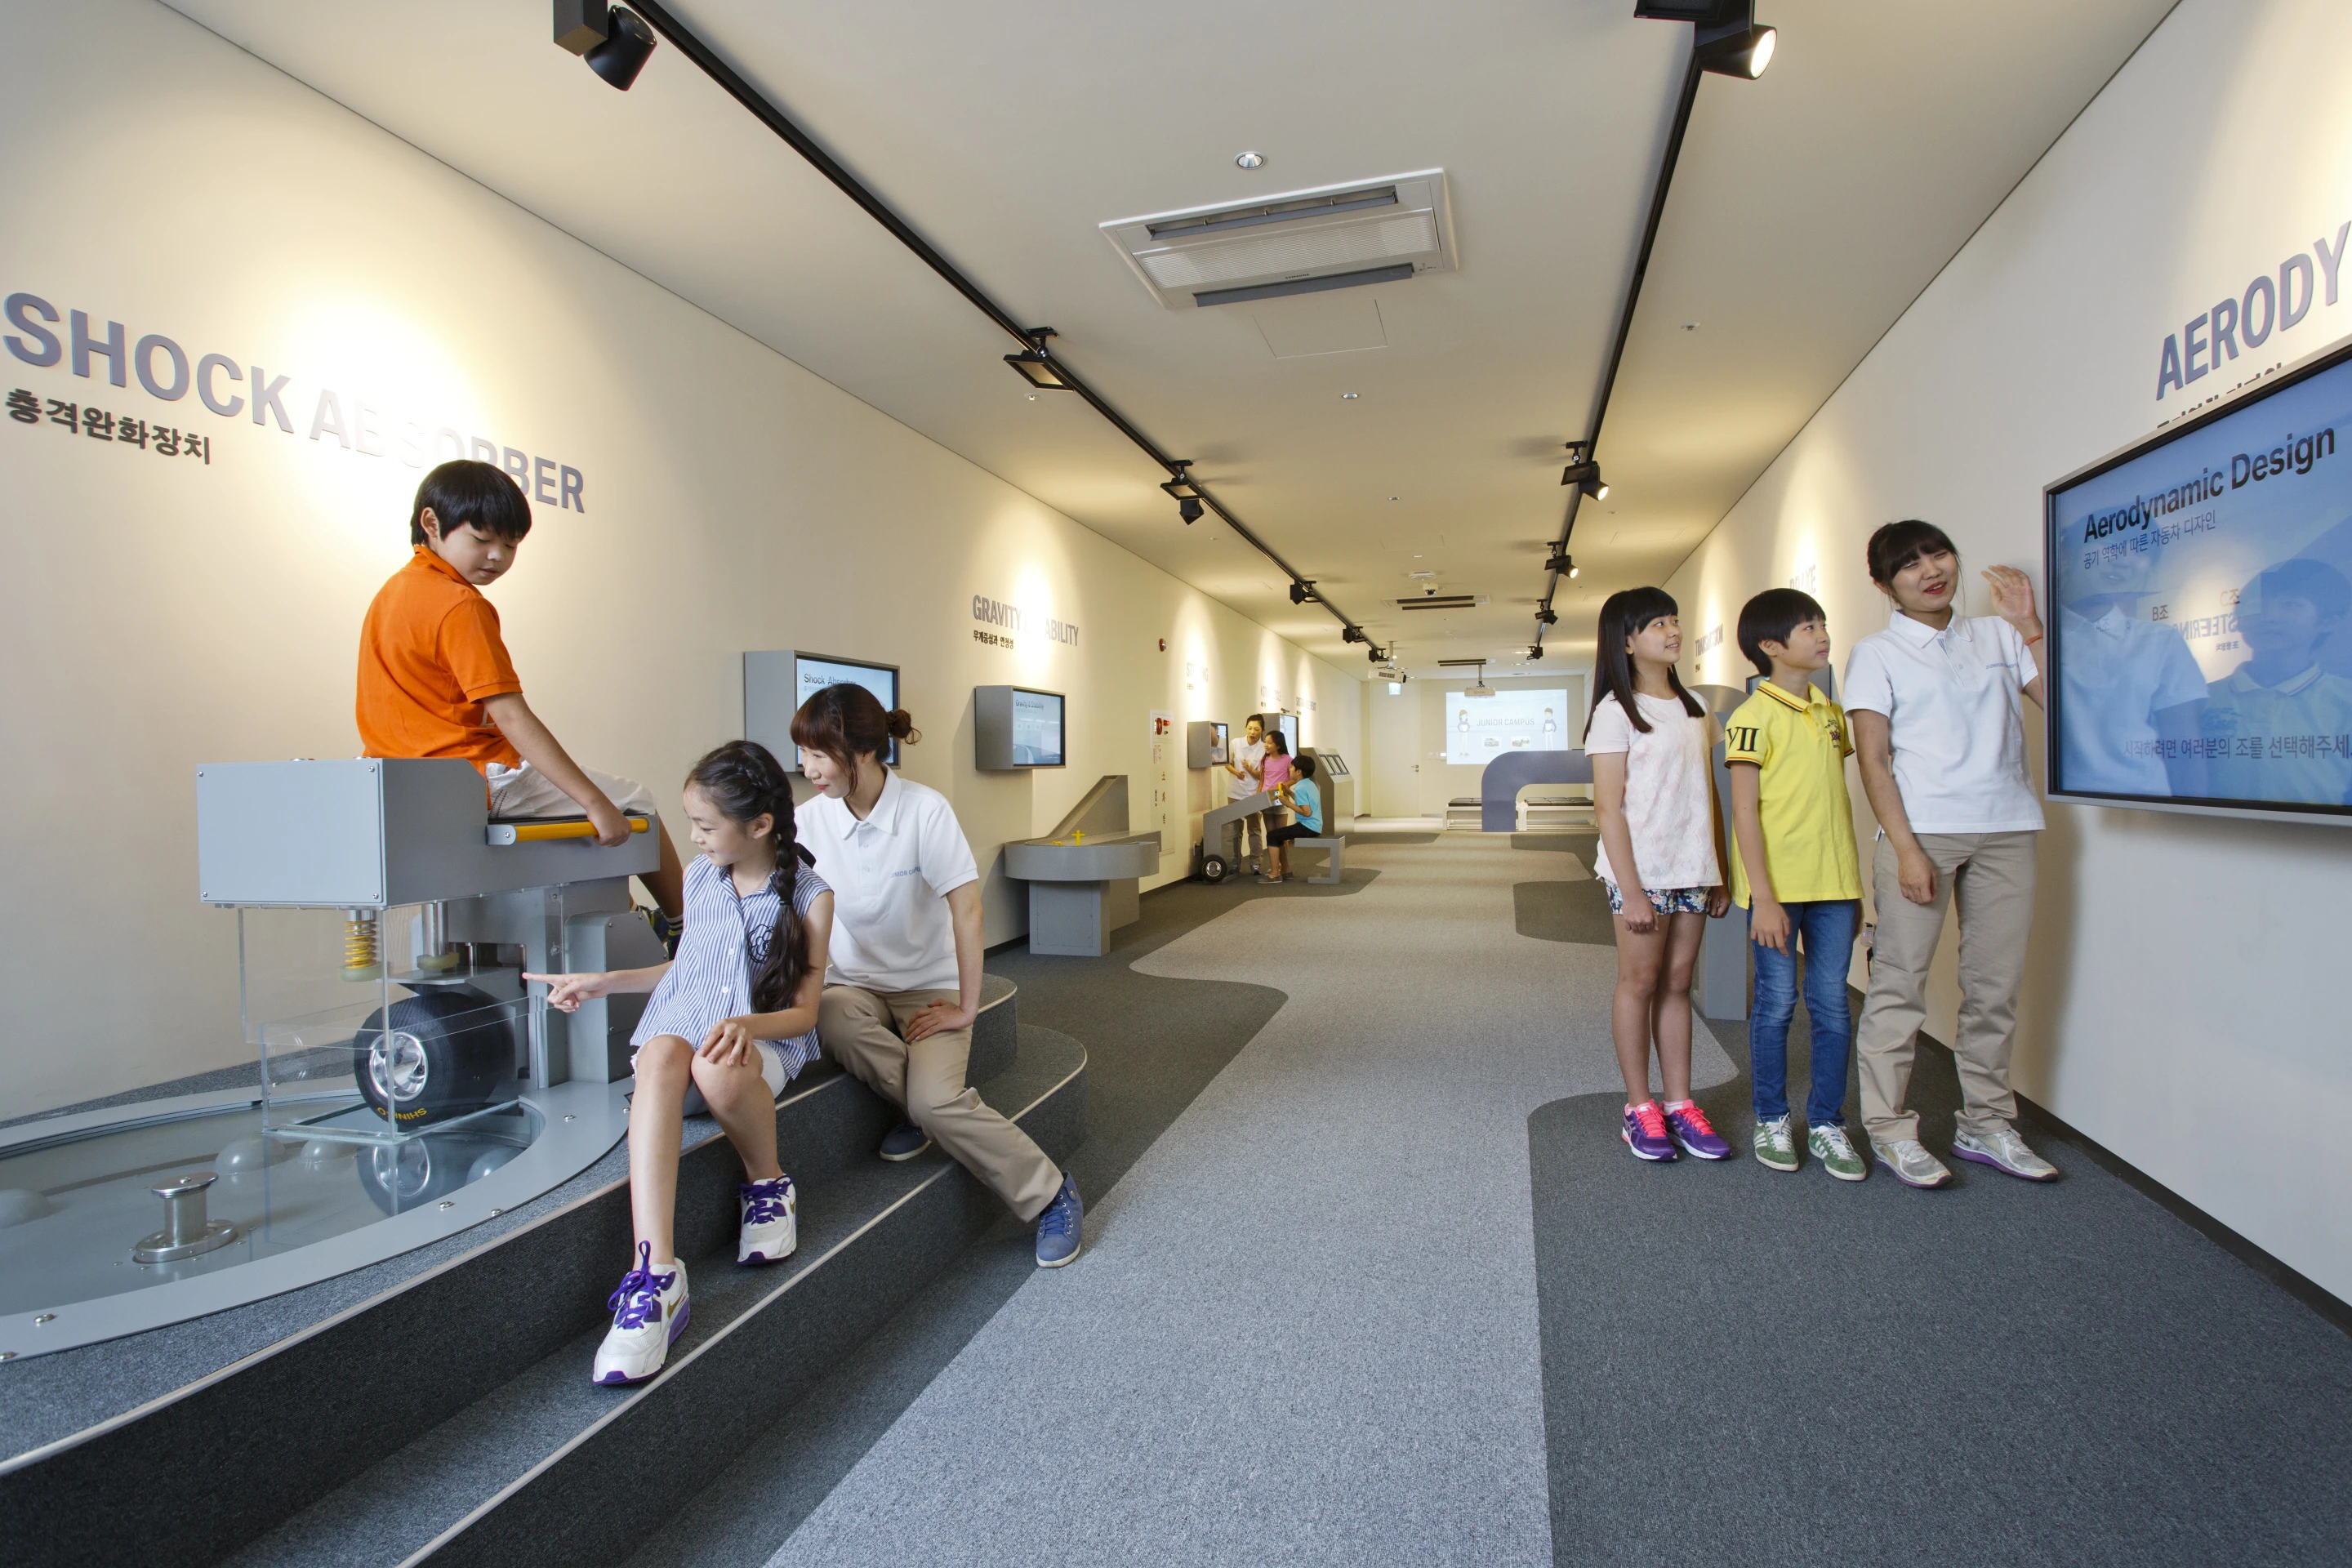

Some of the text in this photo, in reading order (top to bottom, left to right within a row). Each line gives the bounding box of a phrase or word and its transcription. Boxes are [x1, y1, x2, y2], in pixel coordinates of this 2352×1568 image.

[2156, 220, 2351, 401] AERODY
[2, 292, 295, 434] SHOCK
[6, 388, 210, 465] 충격완화장치
[2083, 427, 2335, 544] Aerodynamic Design
[2083, 510, 2216, 569] 공기 역학에 따른 자동차 디자인
[973, 595, 1021, 630] GRAVITY
[2152, 605, 2168, 621] B조
[804, 674, 825, 684] Shock
[1504, 718, 1535, 726] CAMPUS
[1726, 727, 1760, 751] VII
[2124, 734, 2352, 760] 시작하려면 여러분의 조를 선택해주세
